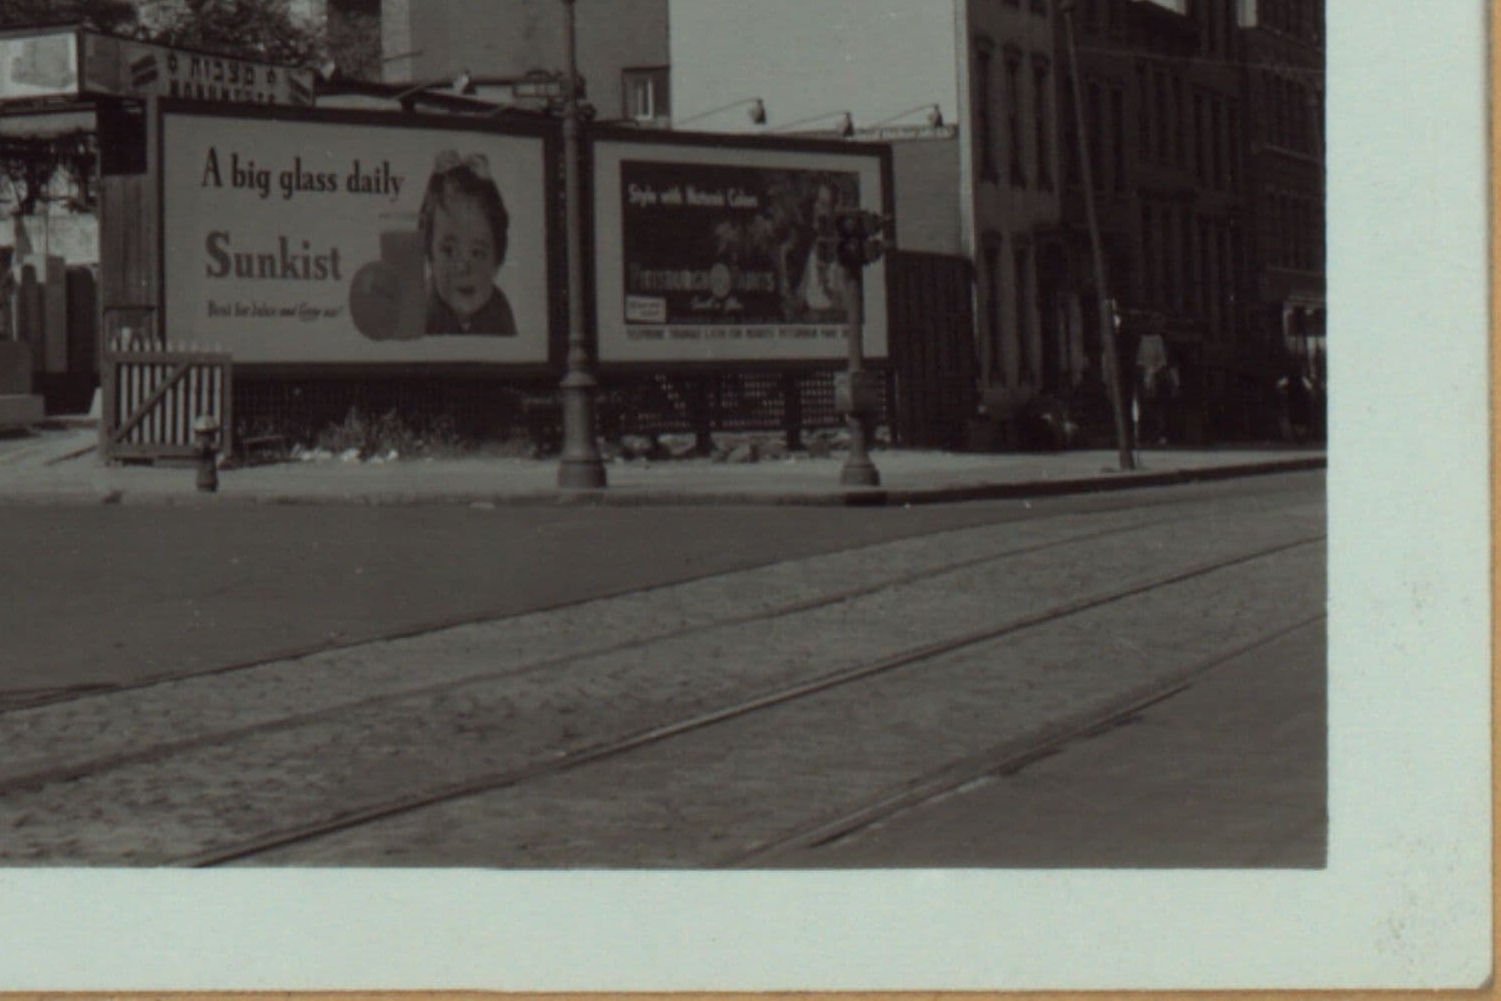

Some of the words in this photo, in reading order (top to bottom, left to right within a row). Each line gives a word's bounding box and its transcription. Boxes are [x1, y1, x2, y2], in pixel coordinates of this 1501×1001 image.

[201, 146, 222, 188] A
[230, 153, 271, 200] big
[279, 156, 337, 200] glass
[346, 159, 404, 203] daily
[205, 230, 342, 281] Sunkist
